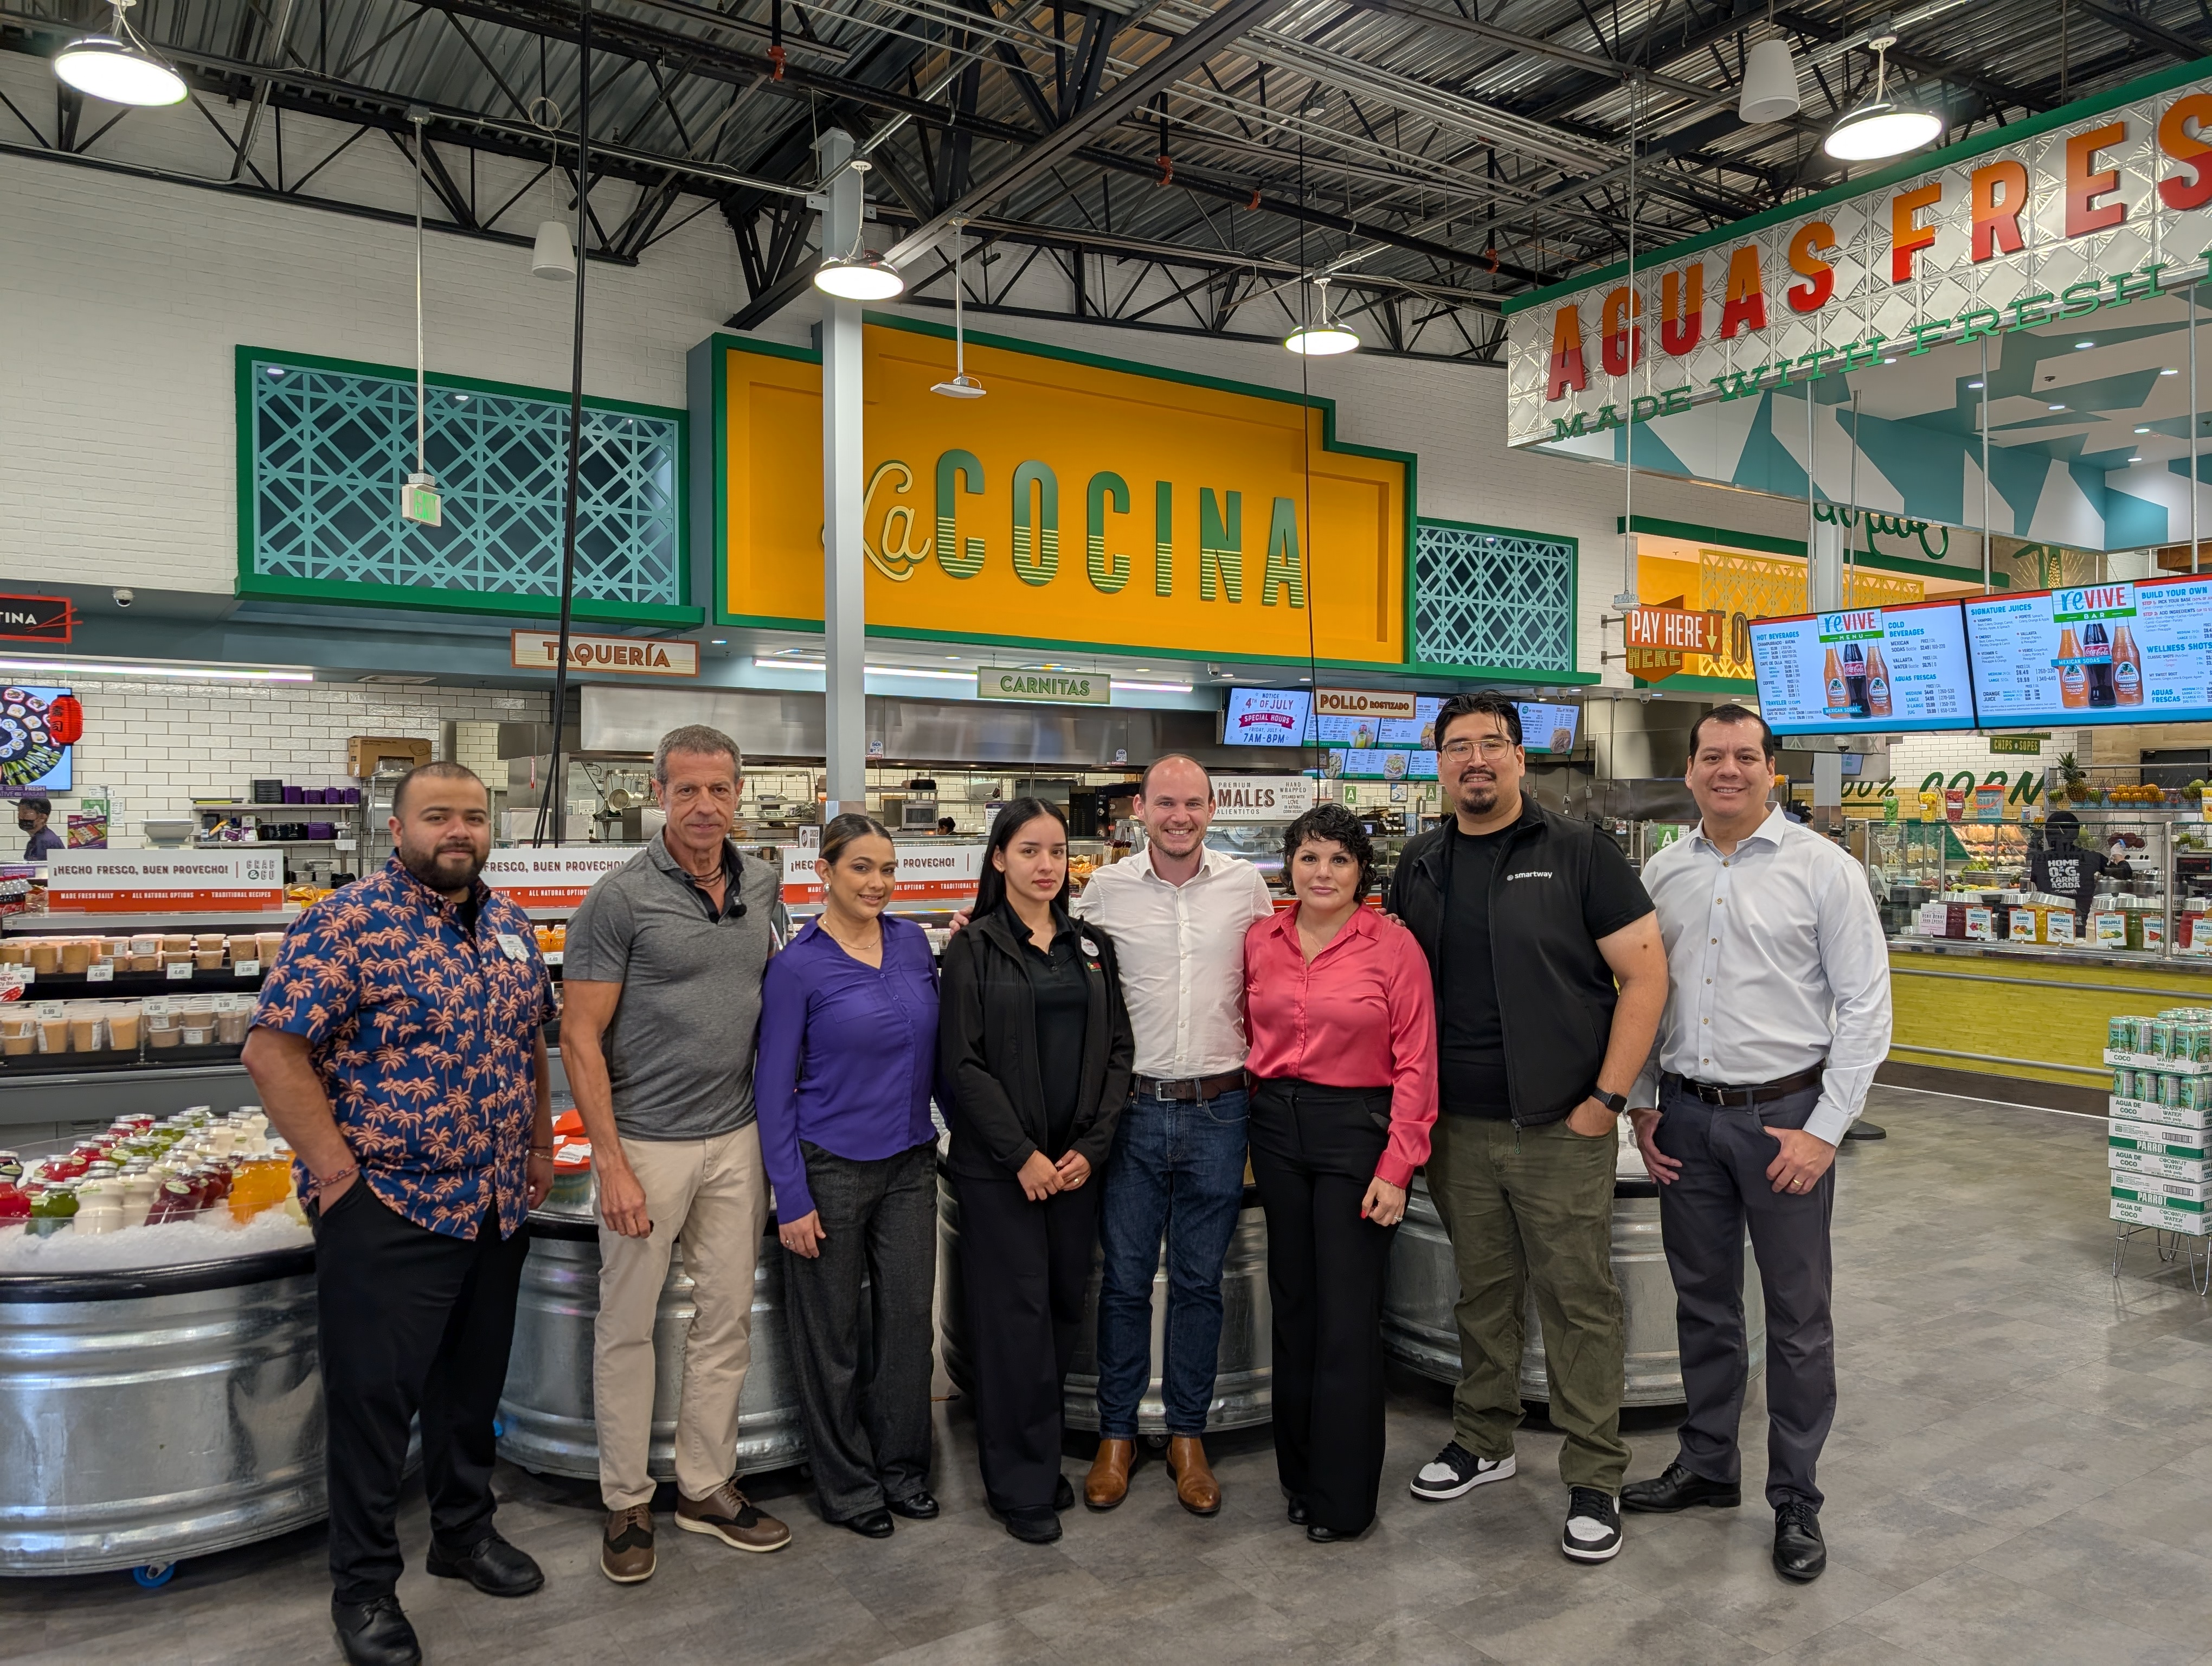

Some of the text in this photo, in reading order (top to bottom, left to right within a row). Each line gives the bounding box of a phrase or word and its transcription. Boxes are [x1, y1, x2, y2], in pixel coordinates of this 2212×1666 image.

[1546, 92, 2212, 402] AGUAS FRES
[1550, 385, 1693, 442] MADE
[1711, 335, 1885, 402] WITH
[1908, 262, 2166, 357] FRESH
[936, 448, 1305, 609] COCINA
[2142, 587, 2207, 599] BUILD YOUR OWN
[1971, 604, 2031, 615] SIGNATURE JUICES
[0, 611, 37, 624] INA
[1631, 610, 1702, 648] PAY HERE
[1889, 629, 1924, 637] BEVERAGES
[1769, 631, 1799, 639] BEVERAGES
[2146, 642, 2212, 653] WELLNESS SHOTS
[1000, 675, 1090, 696] CARNITAS
[1260, 700, 1269, 708] OF
[1270, 700, 1294, 710] JULY
[1320, 694, 1410, 710] POLLO ROSTIZADO
[1244, 714, 1290, 725] SPECIAL HOURS
[1243, 733, 1285, 744] 7AM-8PM
[1994, 740, 2037, 751] CHIPS SOPES
[1217, 789, 1275, 808] MALES
[1347, 790, 1354, 800] A
[1428, 789, 1435, 798] A
[533, 861, 561, 872] BUEN
[903, 858, 955, 868] PROVECHO!
[54, 865, 229, 876] ¡HECHO FRESCO, BUEN PROVECHO!
[261, 869, 275, 880] GO
[2137, 1140, 2167, 1154] PARROT
[2159, 1157, 2187, 1166] COCONUT
[2137, 1192, 2168, 1206] PARROT
[2116, 1202, 2133, 1210] AGUA
[2159, 1209, 2187, 1219] COCONUT
